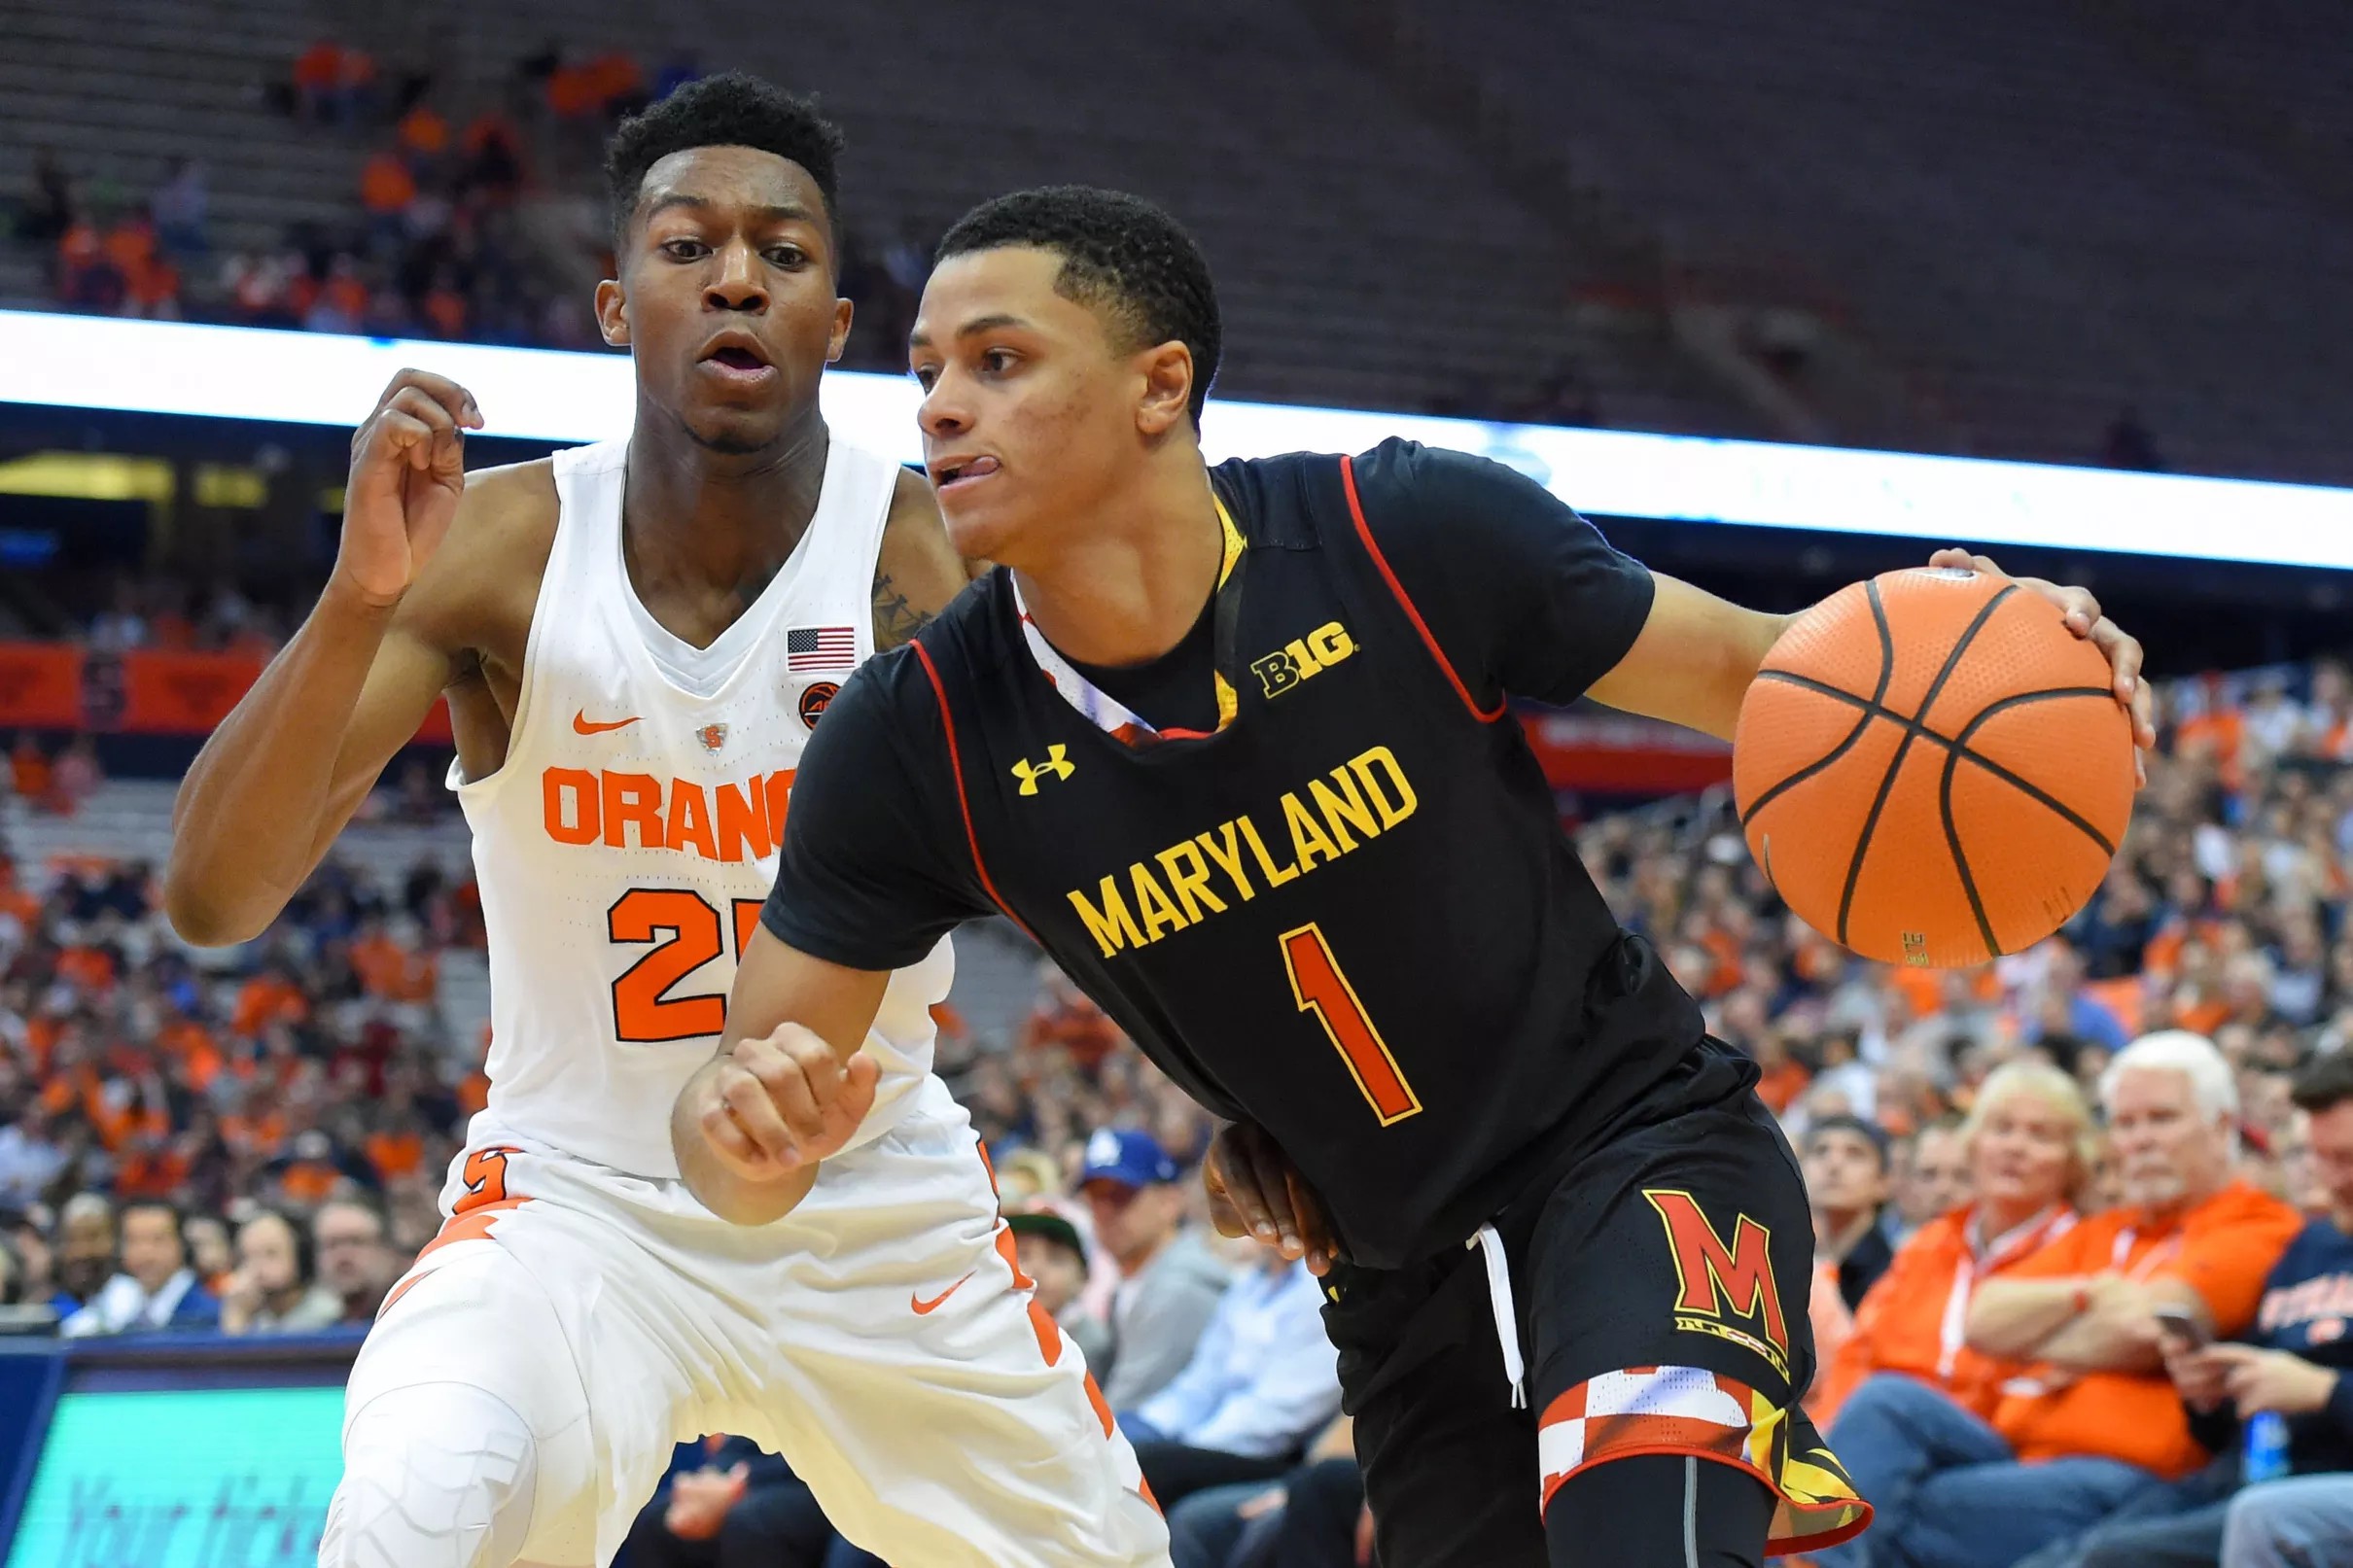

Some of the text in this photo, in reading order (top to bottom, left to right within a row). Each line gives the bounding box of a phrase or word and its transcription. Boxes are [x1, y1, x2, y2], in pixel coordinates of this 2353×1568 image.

[705, 725, 721, 749] S
[1067, 746, 1417, 959] MARYLAND
[607, 888, 767, 1042] 2
[1279, 922, 1422, 1128] 1
[1641, 1189, 1789, 1362] M
